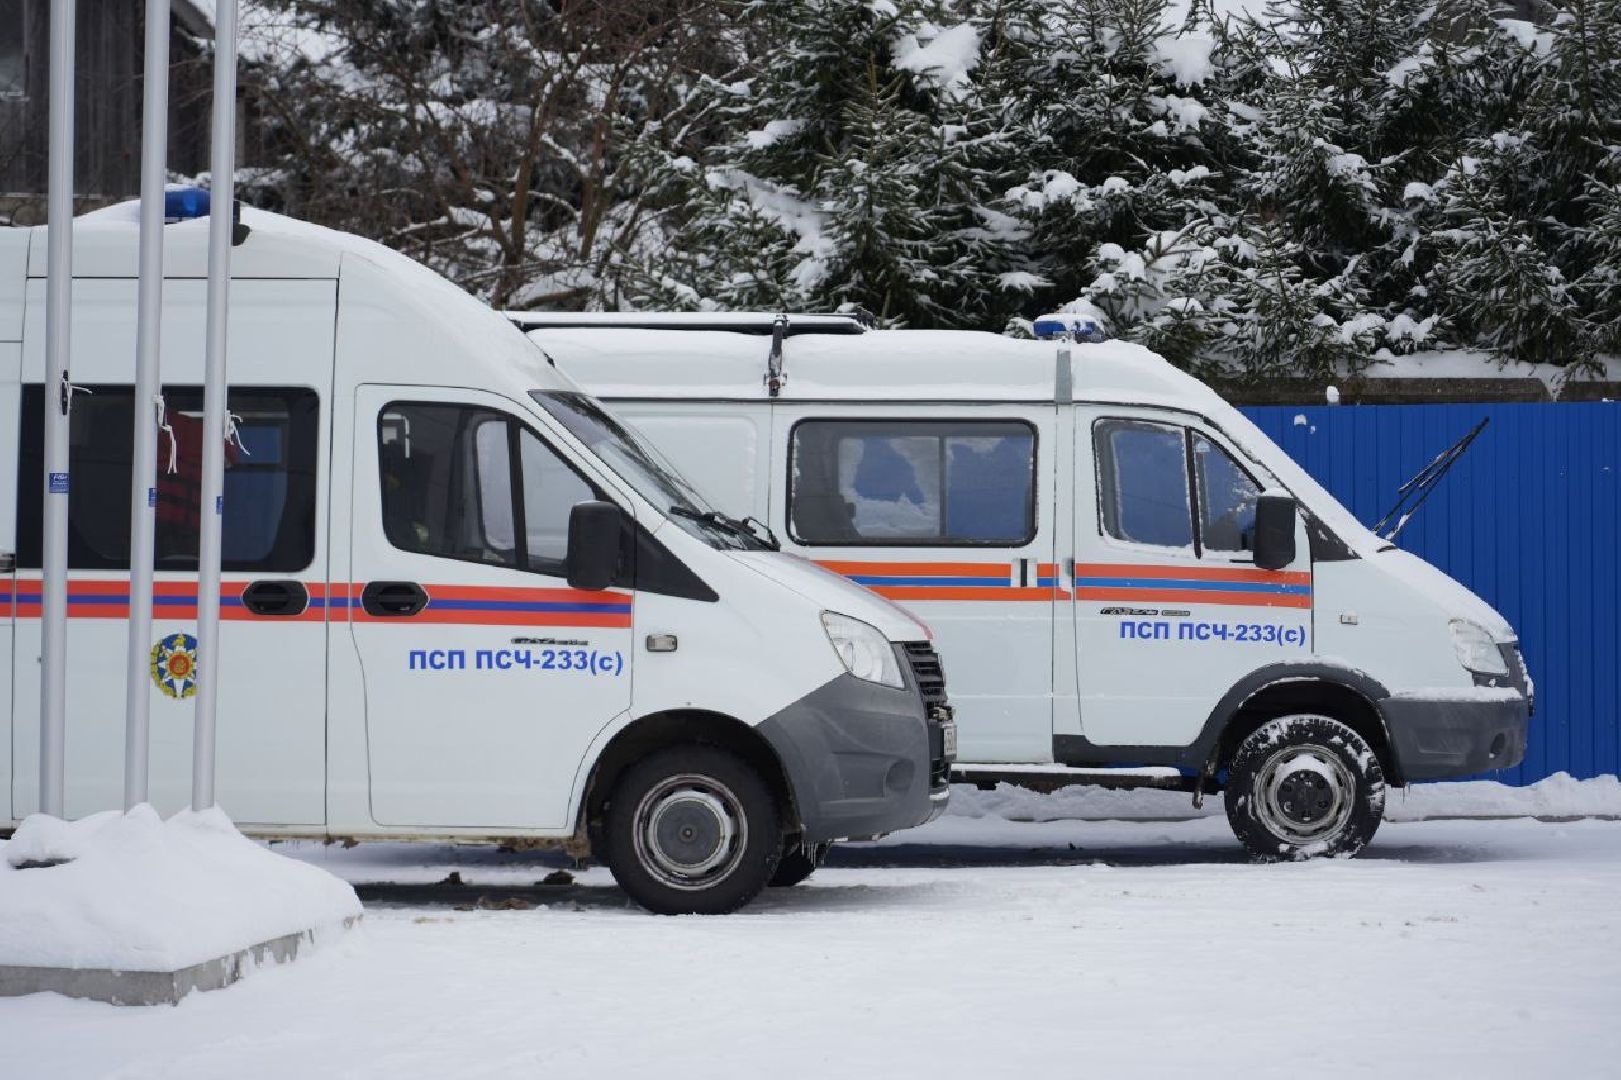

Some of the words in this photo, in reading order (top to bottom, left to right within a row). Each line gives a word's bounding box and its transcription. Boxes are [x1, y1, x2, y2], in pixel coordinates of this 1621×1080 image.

[1120, 621, 1170, 640] ПСП
[1178, 623, 1306, 646] ПСЧ-233(с)
[408, 649, 466, 670] ПСП
[475, 649, 624, 676] ПСЧ-233(с)
